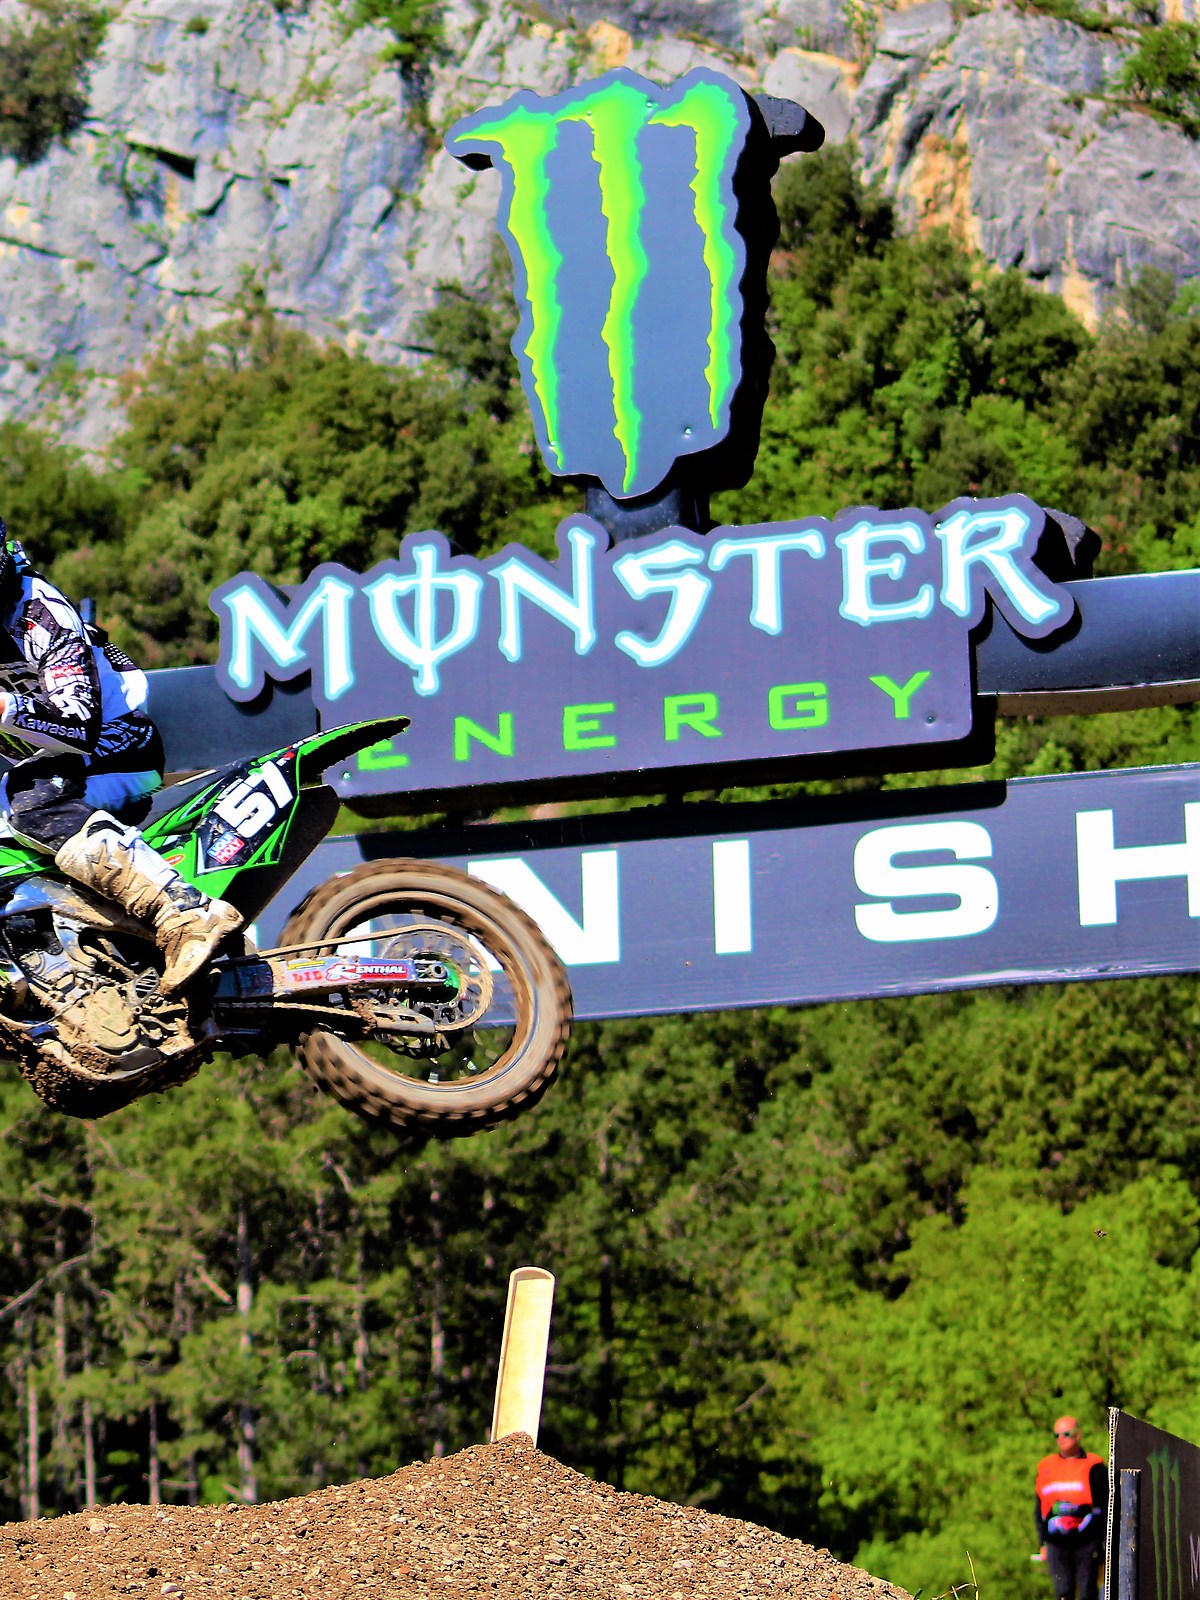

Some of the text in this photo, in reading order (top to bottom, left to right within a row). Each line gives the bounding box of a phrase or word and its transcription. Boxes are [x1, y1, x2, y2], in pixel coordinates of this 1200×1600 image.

[223, 507, 1059, 699] MONSTER
[357, 671, 931, 771] ENERGY
[213, 761, 293, 838] 57
[216, 839, 244, 862] MOLY
